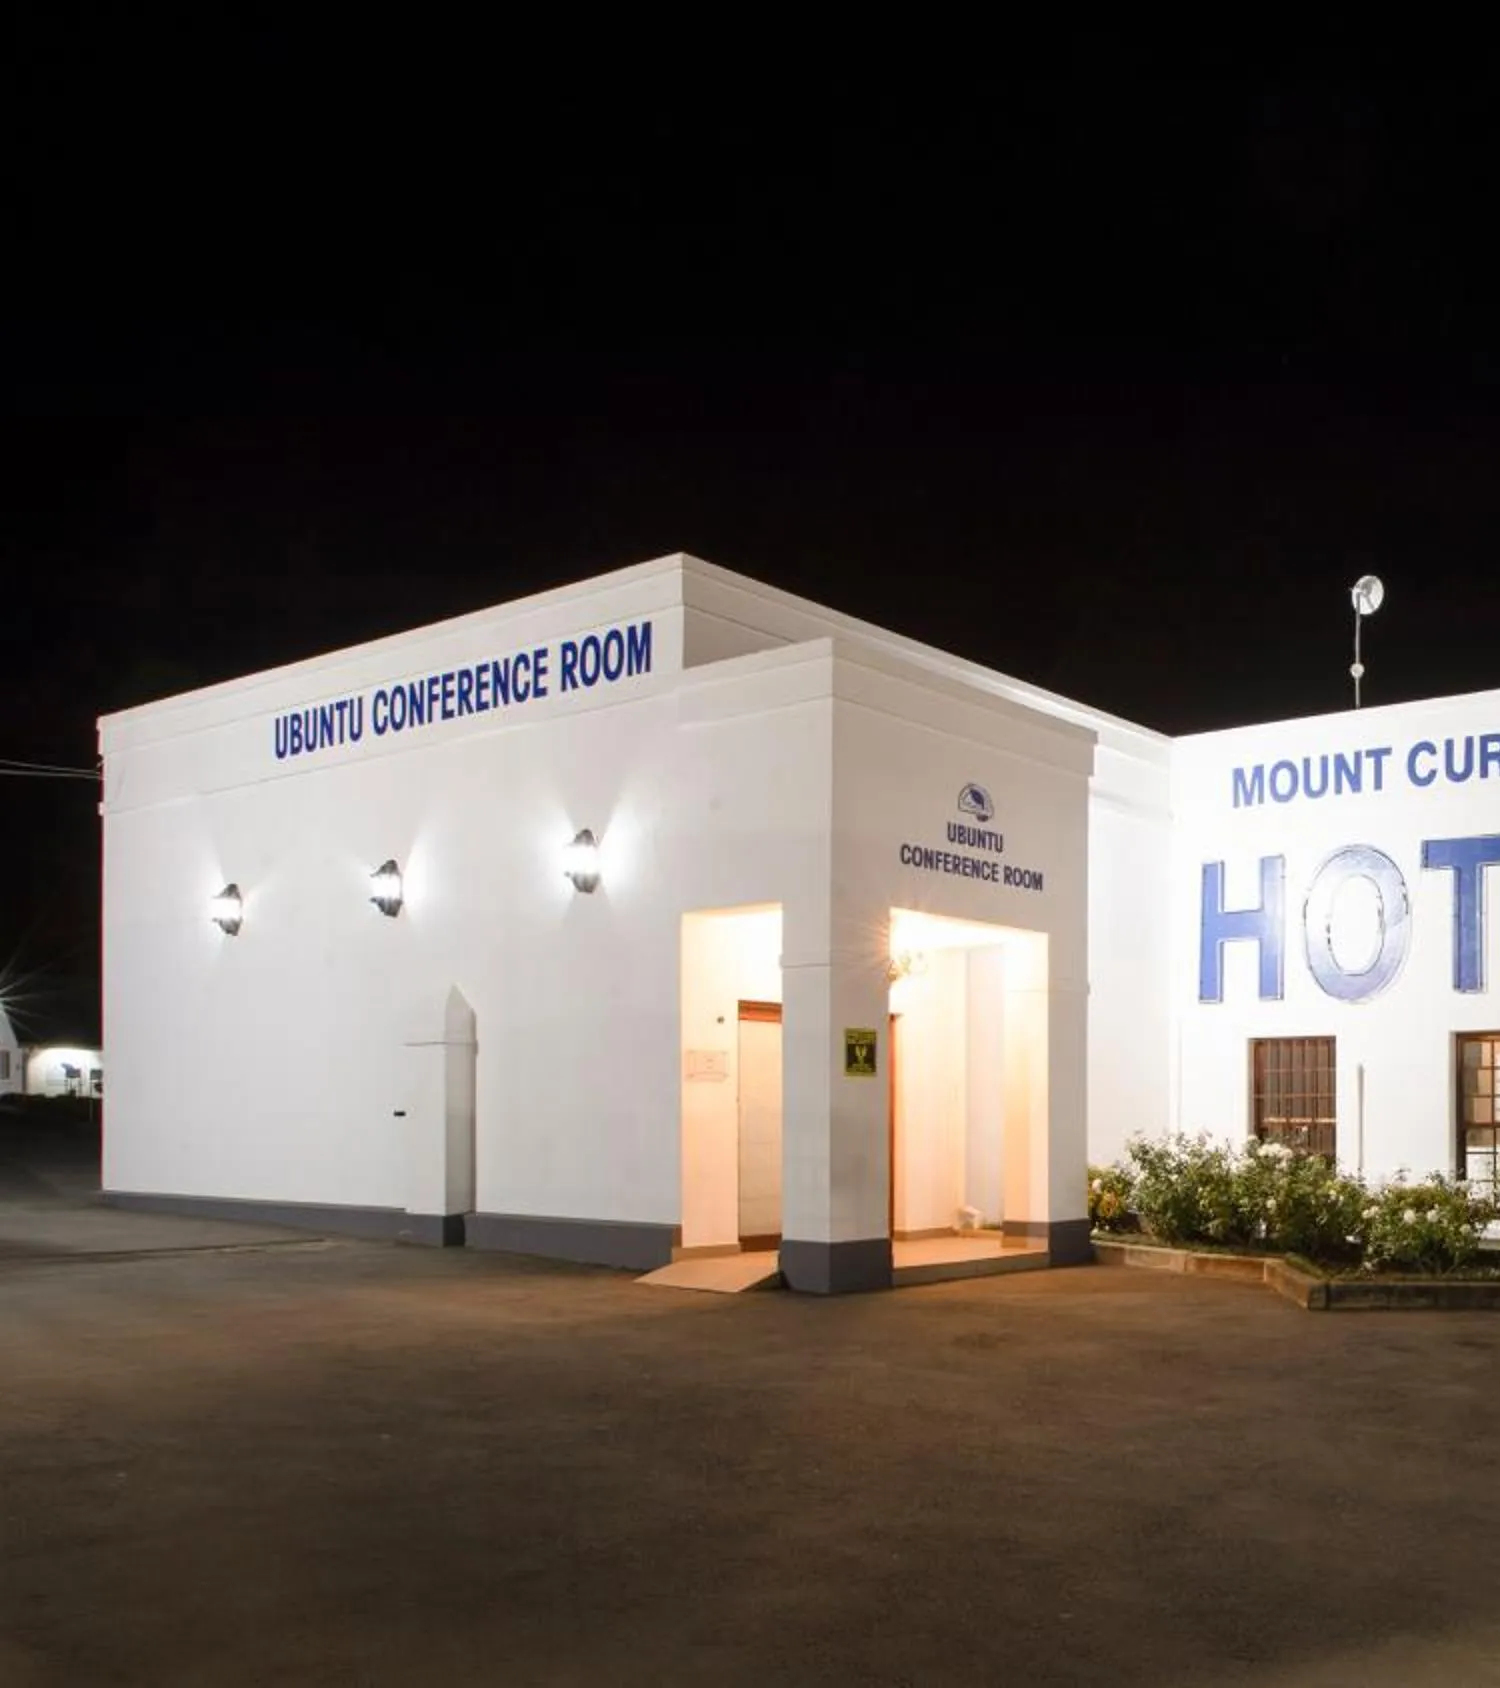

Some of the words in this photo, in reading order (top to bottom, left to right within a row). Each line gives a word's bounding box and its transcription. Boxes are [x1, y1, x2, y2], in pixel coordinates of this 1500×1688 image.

[275, 697, 363, 759] UBUNTU
[372, 648, 549, 736] CONFERENCE
[560, 621, 653, 692] ROOM
[1232, 747, 1392, 808] MOUNT
[947, 821, 1004, 853] UBUNTU
[900, 843, 1000, 882] CONFERENCE
[1003, 865, 1043, 892] ROOM
